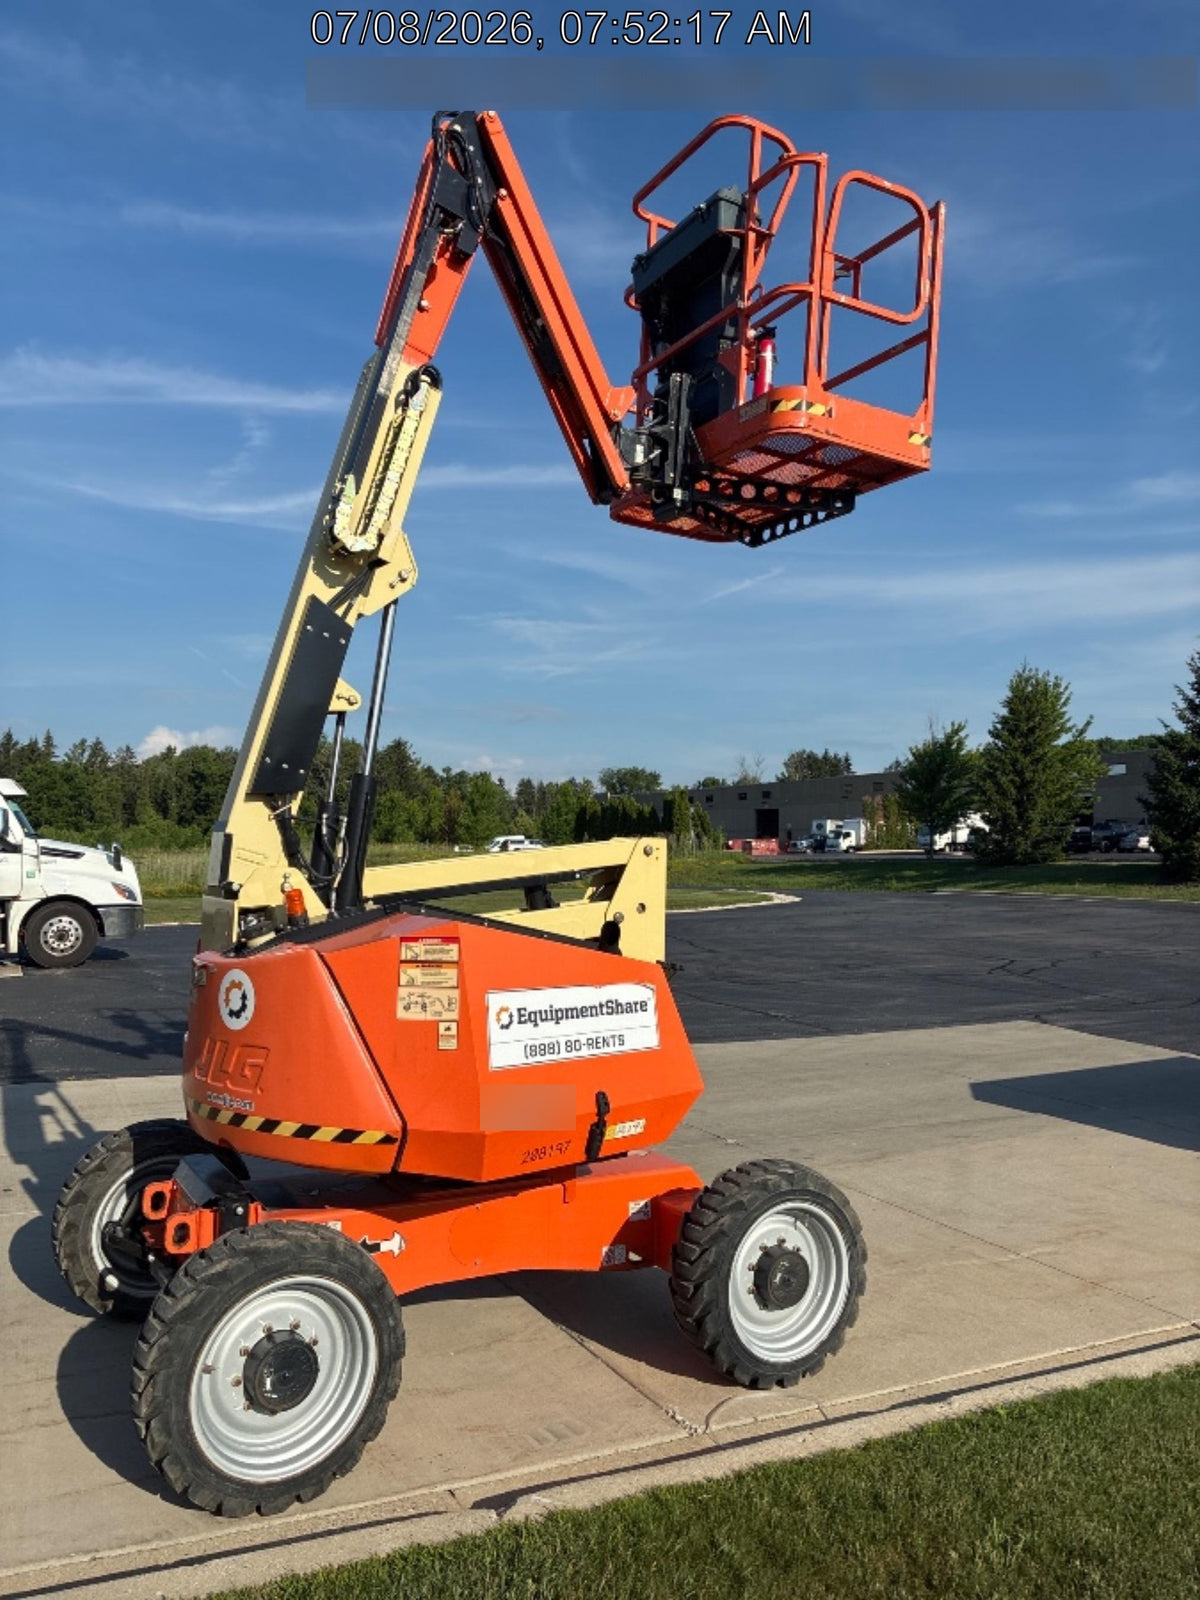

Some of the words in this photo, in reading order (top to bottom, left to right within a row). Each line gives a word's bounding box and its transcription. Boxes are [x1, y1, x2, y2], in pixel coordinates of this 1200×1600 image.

[516, 999, 648, 1028] EquipmentShare
[523, 1039, 561, 1060] (888)
[564, 1034, 626, 1054] 80-RENTS
[194, 1037, 271, 1093] JLG
